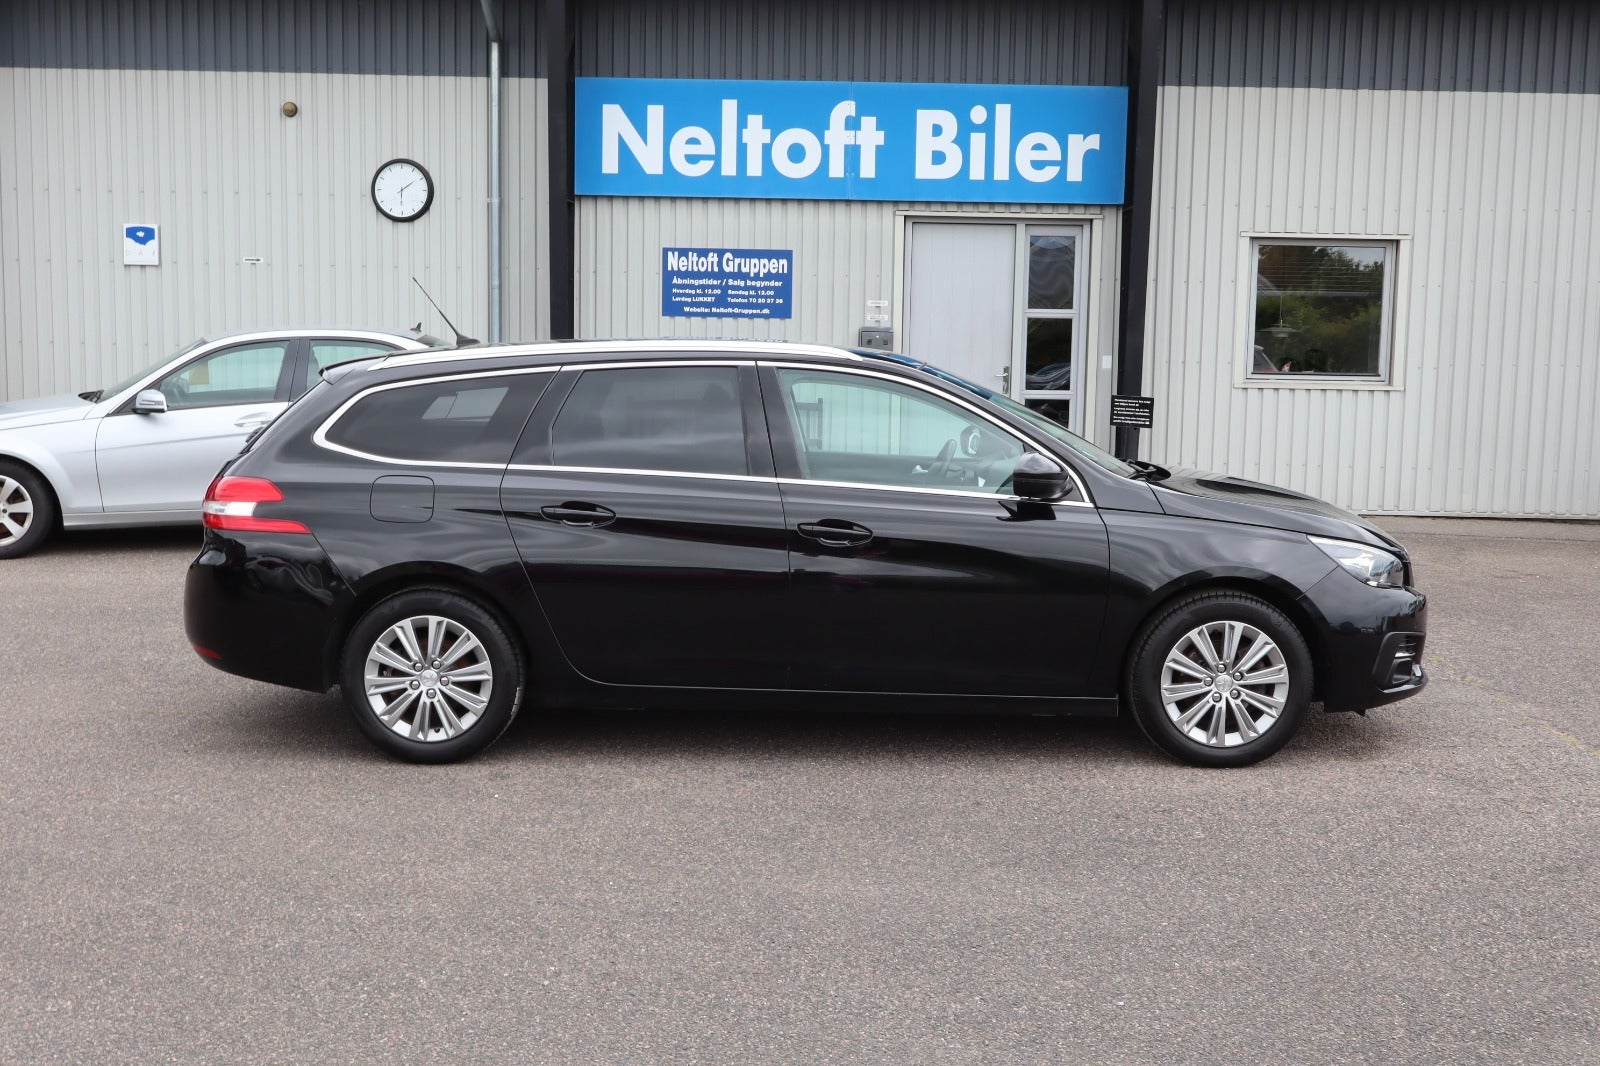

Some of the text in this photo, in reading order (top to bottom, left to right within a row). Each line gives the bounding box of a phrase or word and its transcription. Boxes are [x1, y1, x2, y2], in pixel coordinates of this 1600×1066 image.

[602, 98, 1100, 183] Neltoft Biler
[667, 251, 788, 278] Neltoft Gruppen
[672, 275, 721, 286] Åbningstider
[727, 278, 745, 287] Salg
[746, 279, 783, 287] begynder
